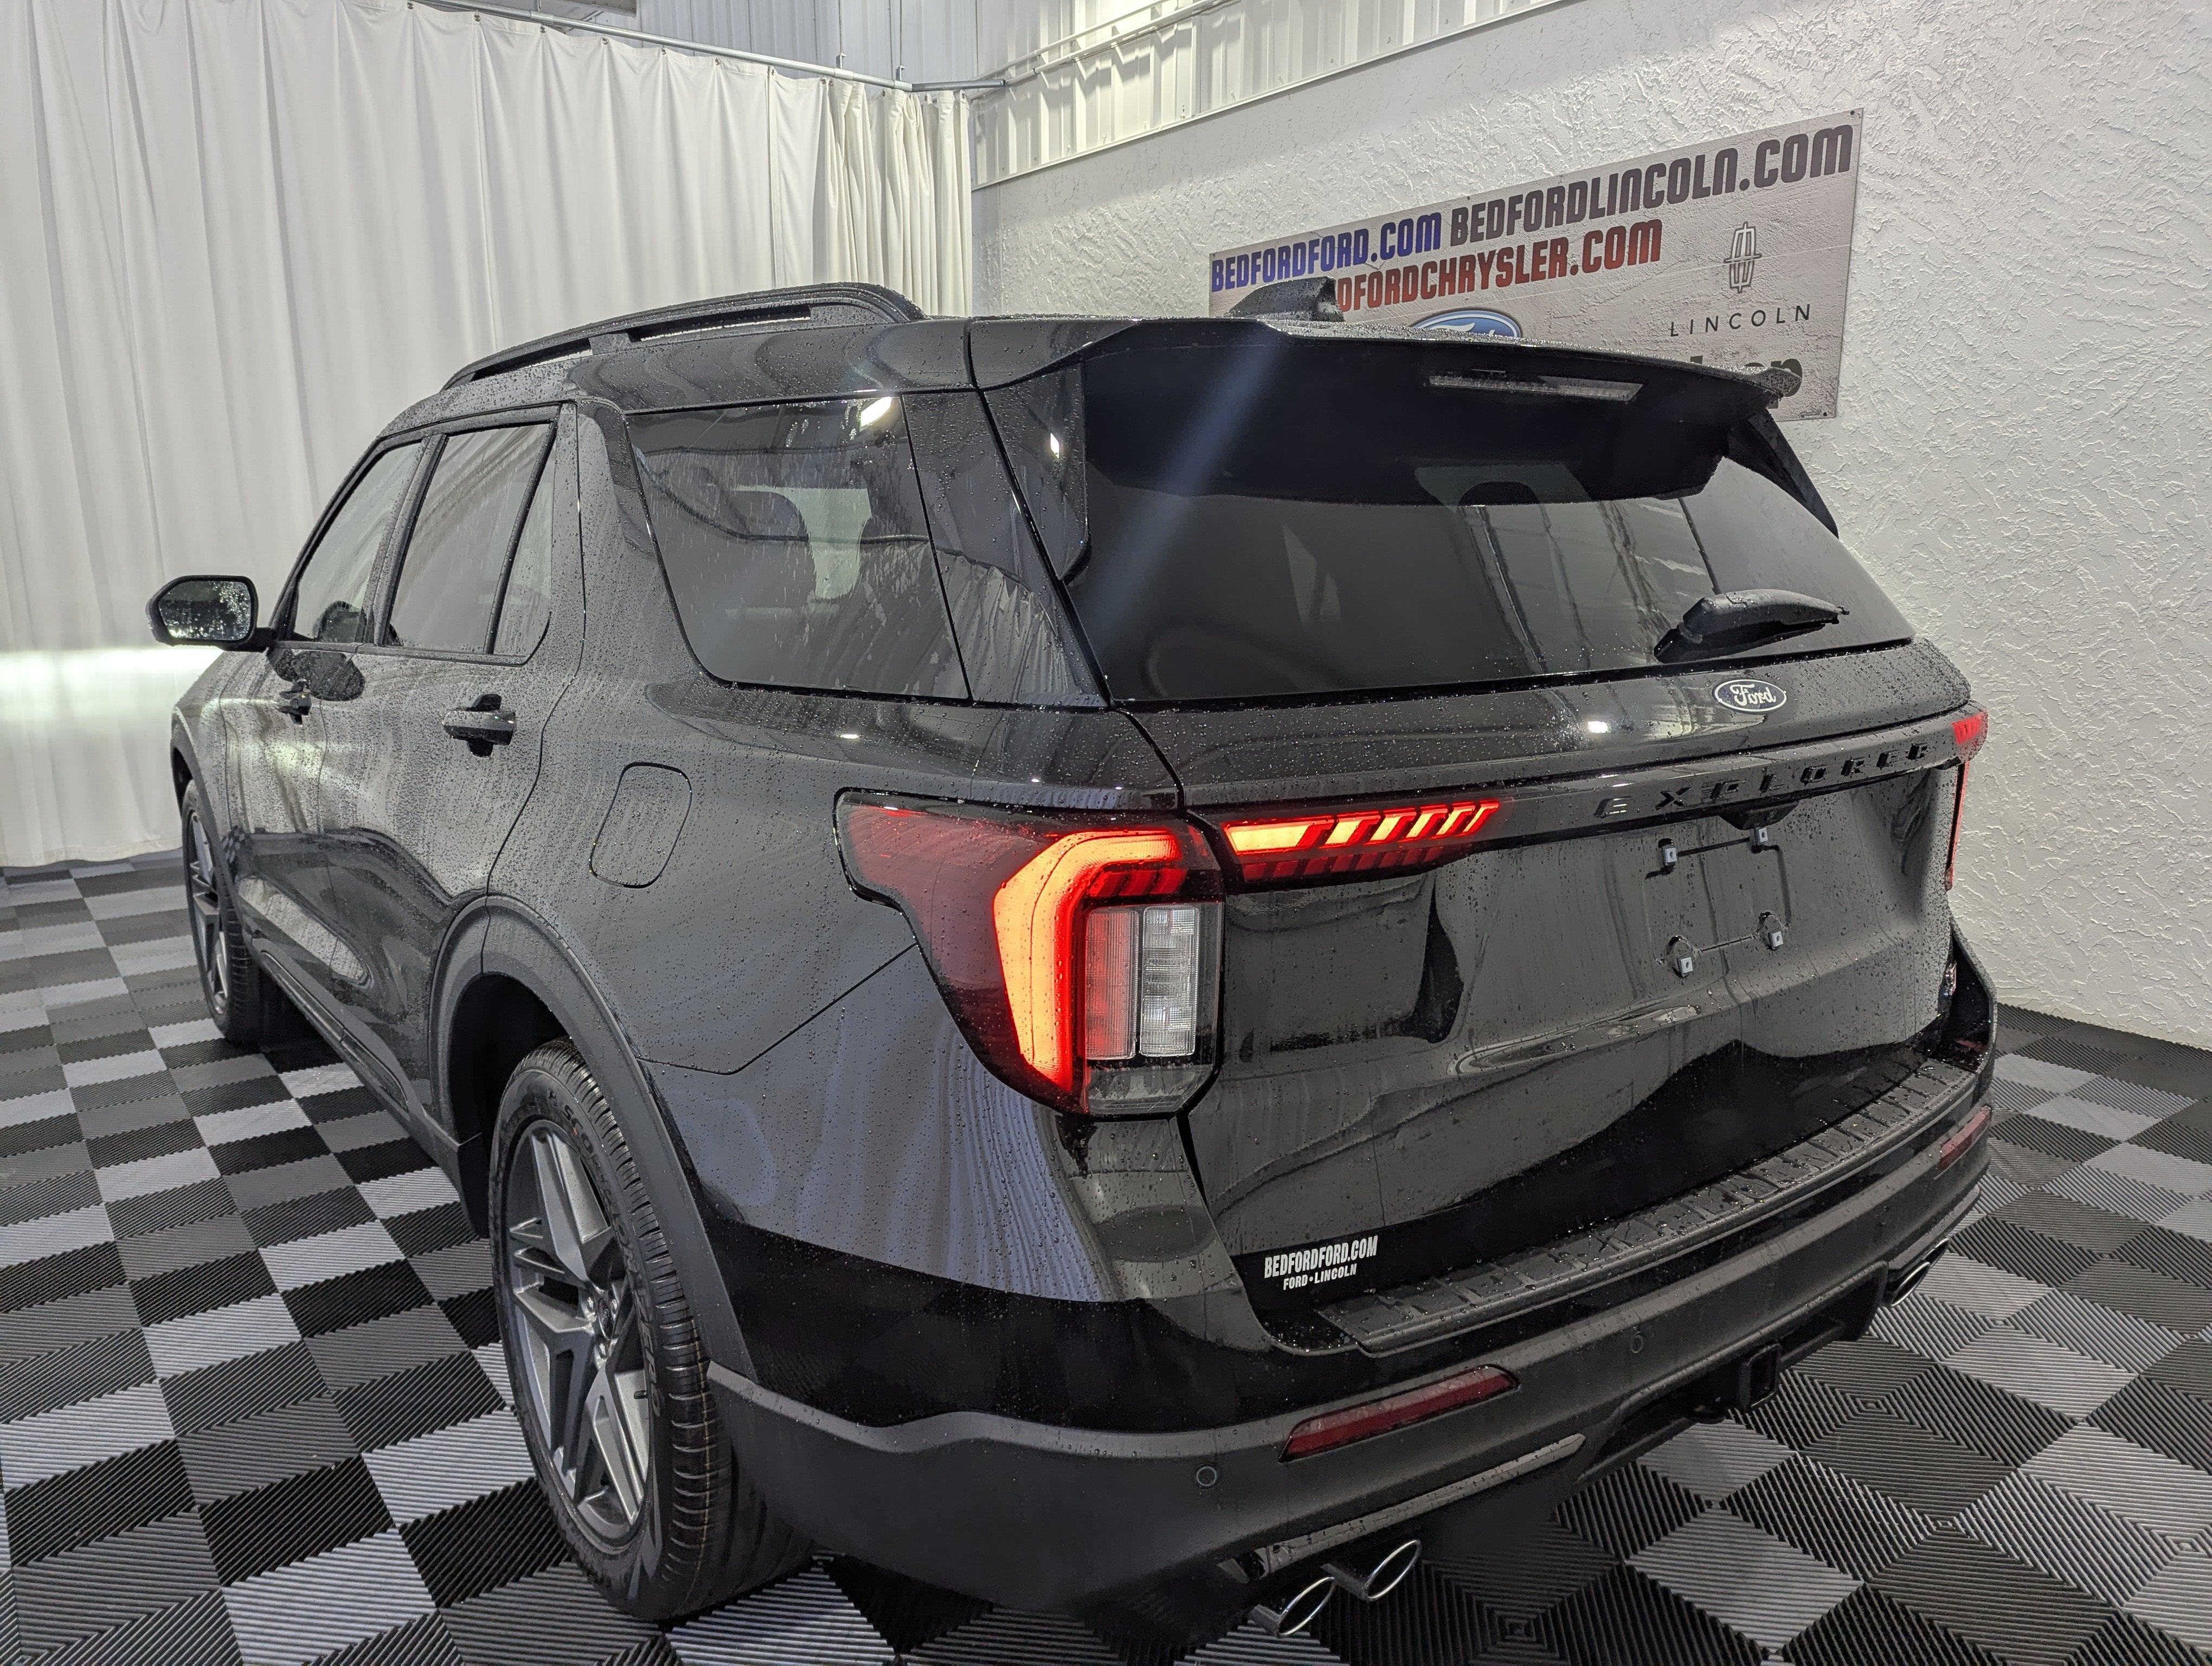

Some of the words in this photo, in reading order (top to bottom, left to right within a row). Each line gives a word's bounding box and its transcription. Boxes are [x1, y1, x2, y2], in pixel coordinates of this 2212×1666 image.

[1211, 212, 1442, 292] BEDFORDFORD.COM
[1450, 124, 1853, 246] BEDFORDLINCOLN.COM
[1338, 219, 1662, 312] DFORDCHRYSLER.COM
[1670, 304, 1810, 337] LINCOLN
[1729, 683, 1777, 706] Ford
[1593, 742, 1930, 818] EXPLORER
[1264, 1235, 1378, 1279] BEDFORDFORD.COM
[1283, 1274, 1308, 1291] FORD
[1314, 1263, 1357, 1284] LINCOLN
